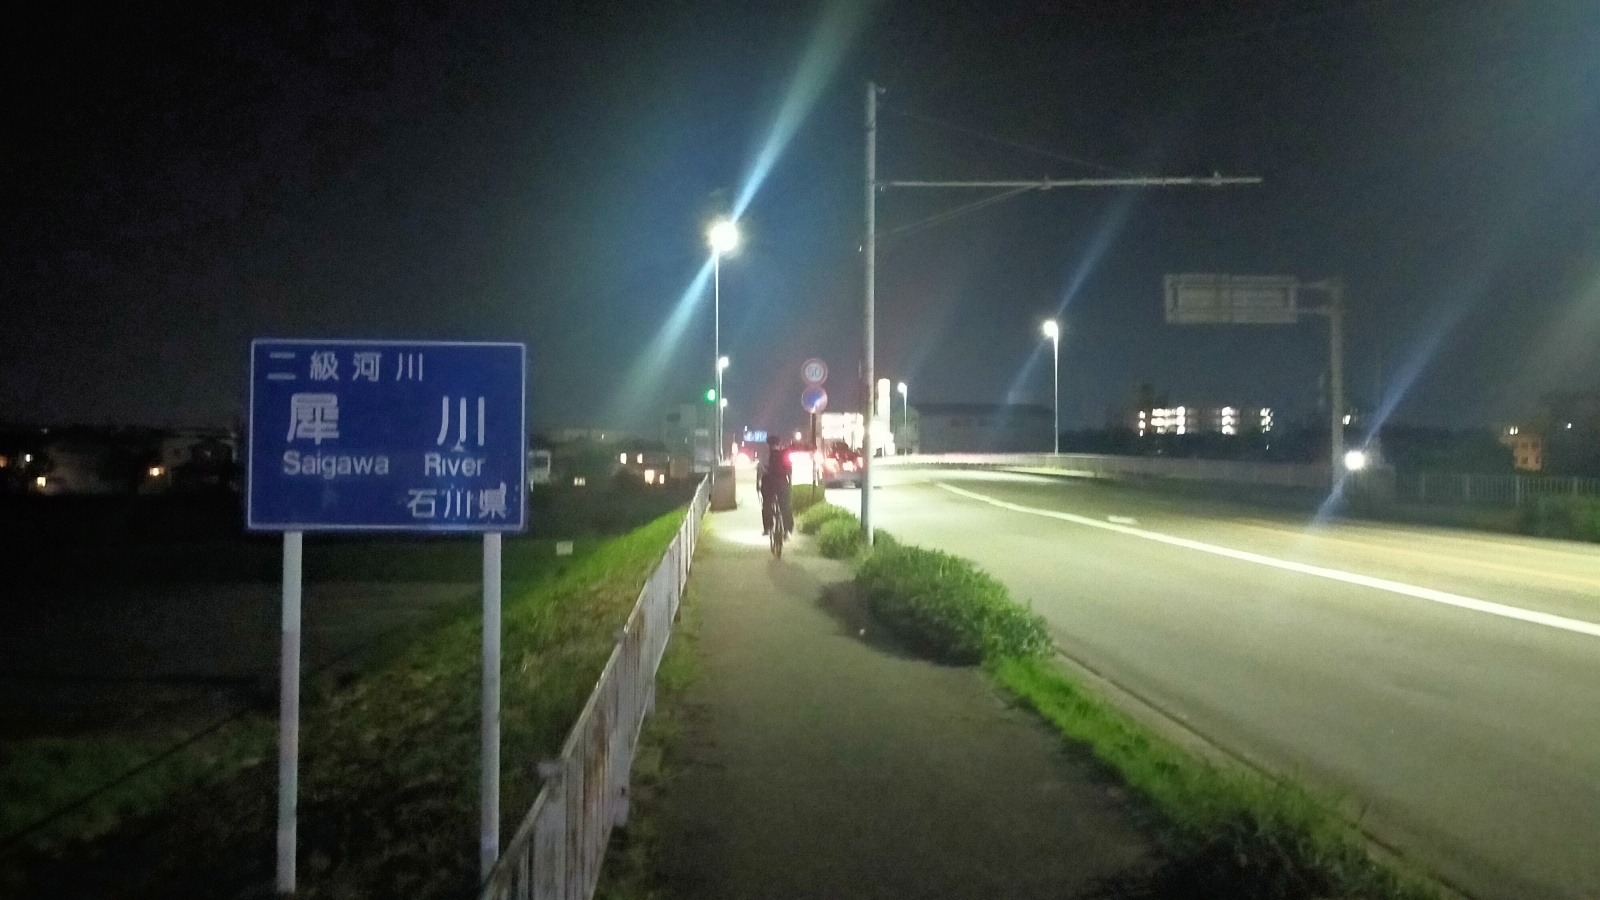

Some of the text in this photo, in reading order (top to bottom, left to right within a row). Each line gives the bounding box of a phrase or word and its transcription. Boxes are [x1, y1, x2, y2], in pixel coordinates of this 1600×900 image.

[267, 352, 423, 381] 二級河川
[283, 452, 487, 479] Saigawa River
[407, 482, 507, 519] 石川県
